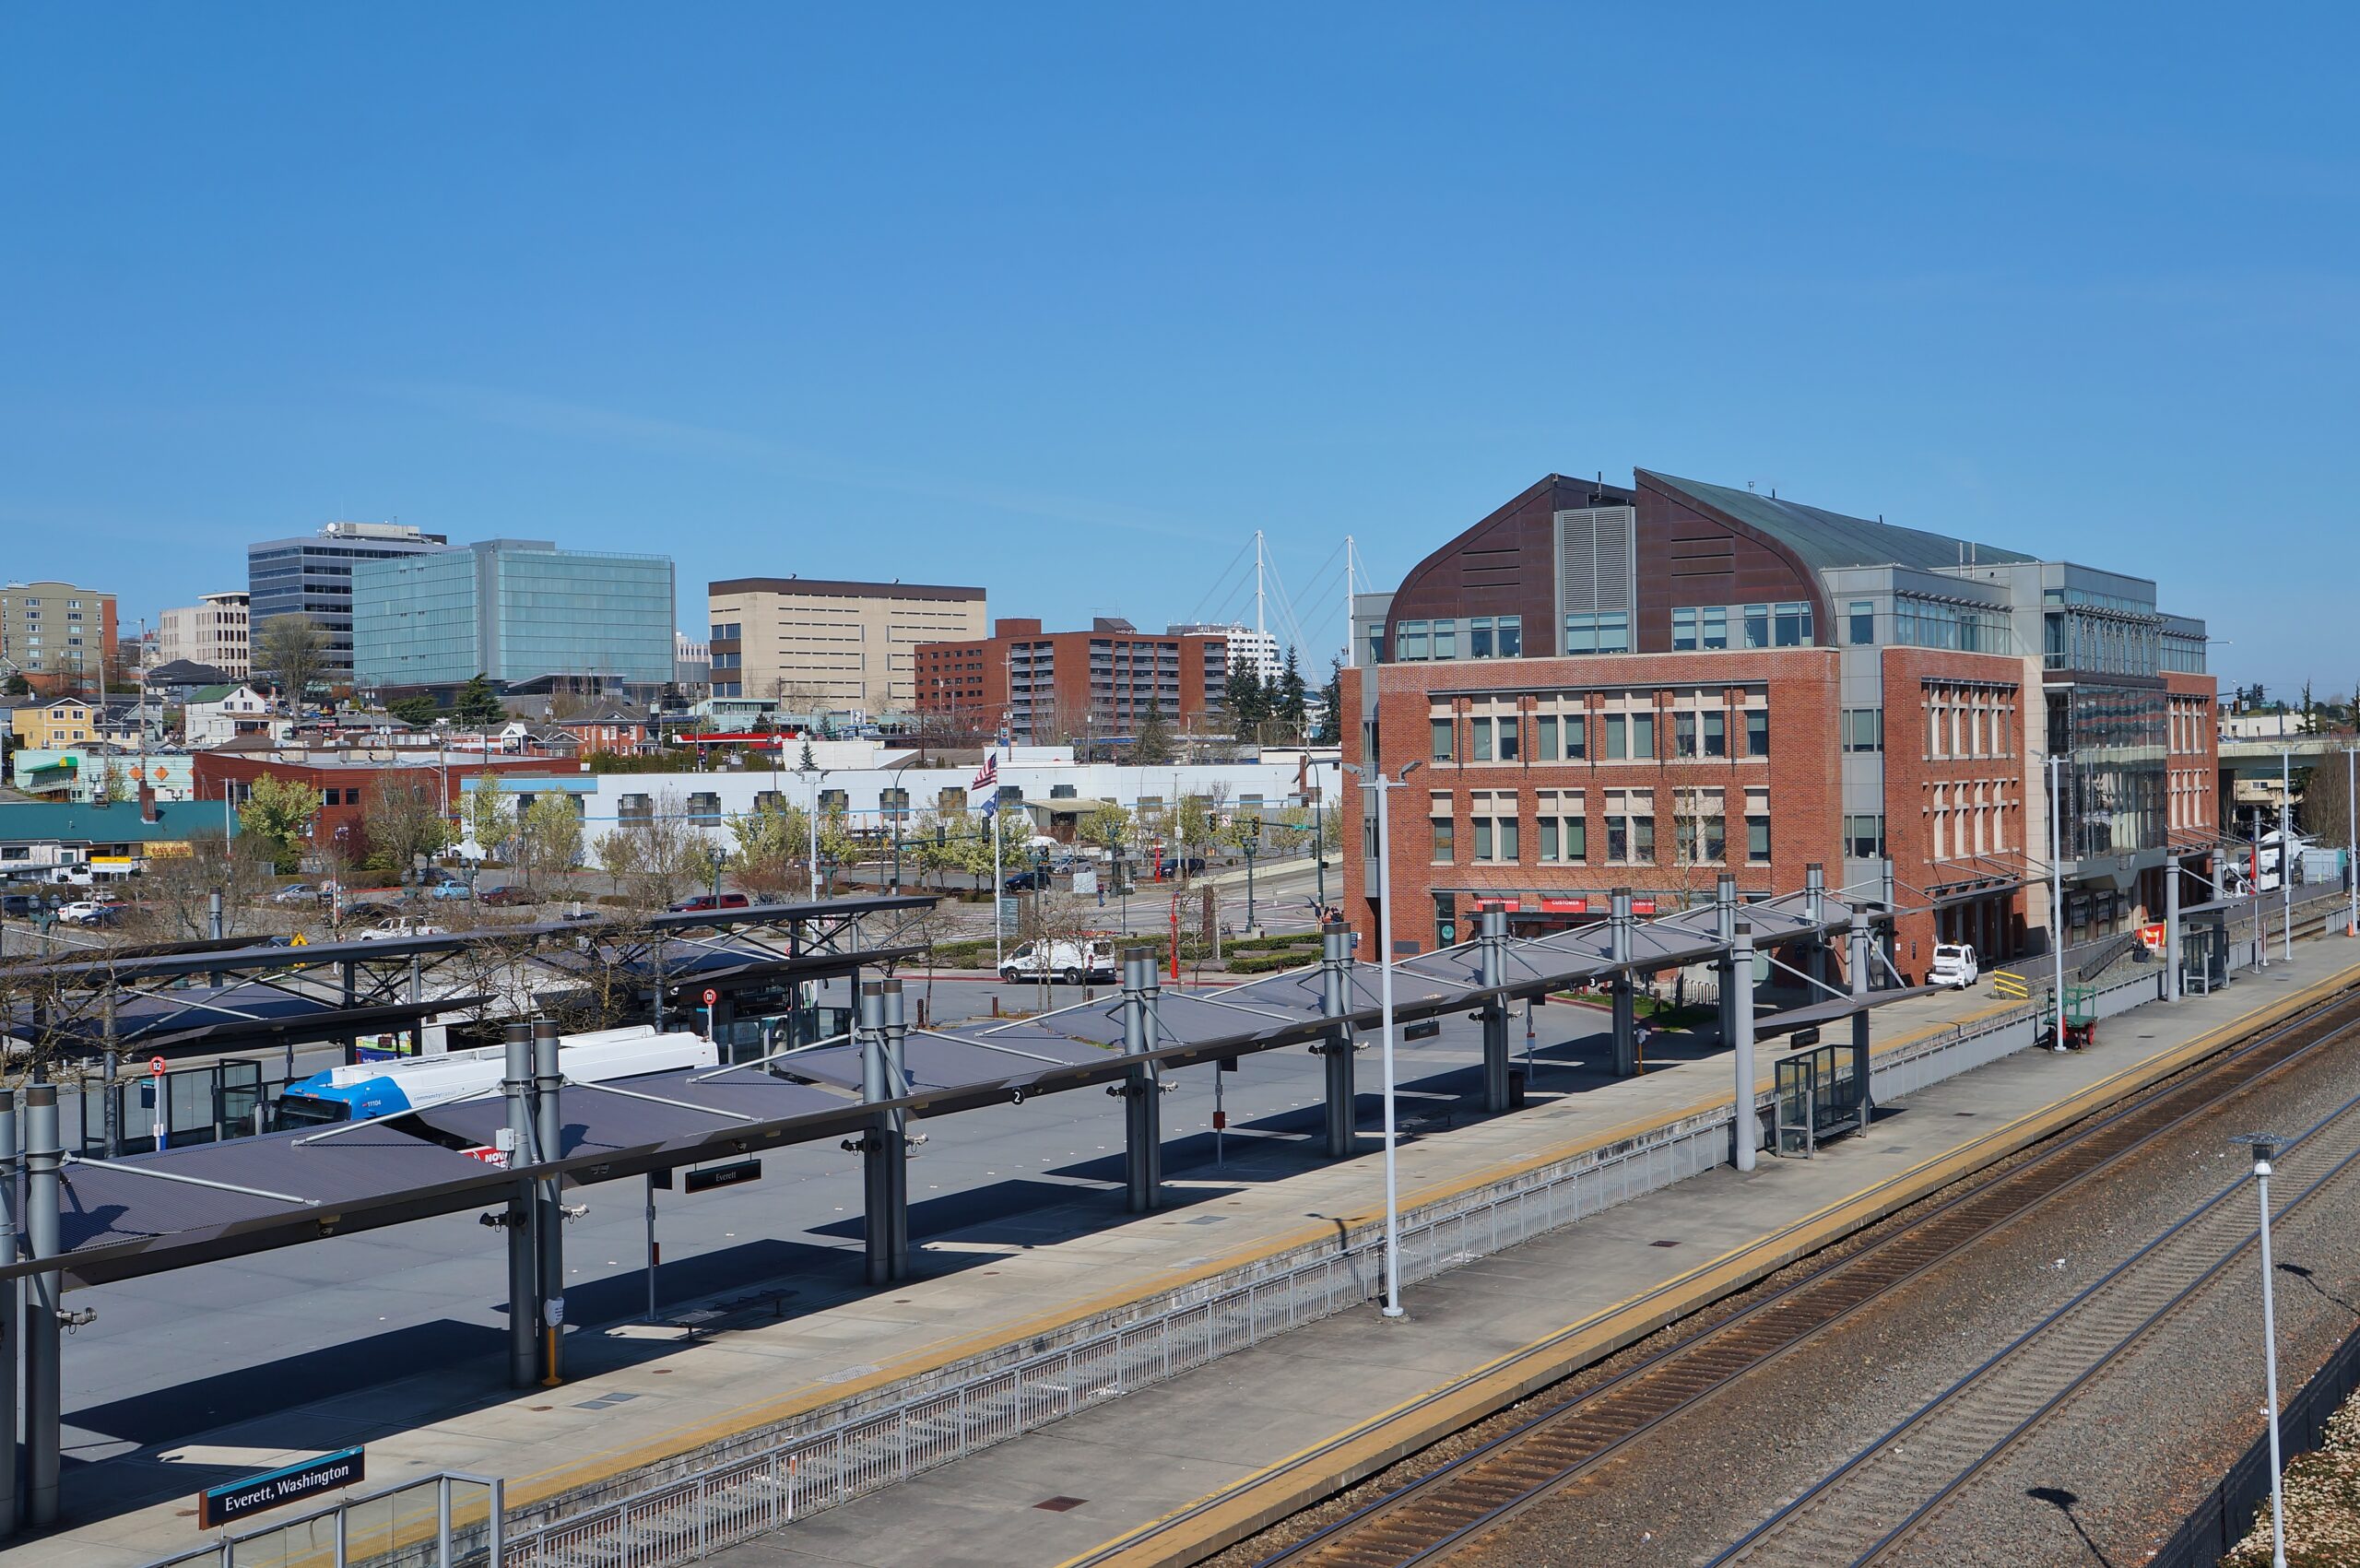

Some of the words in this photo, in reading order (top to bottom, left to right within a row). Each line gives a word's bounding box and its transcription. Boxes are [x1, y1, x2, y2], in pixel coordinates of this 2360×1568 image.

[1589, 977, 1596, 987] 3
[153, 1062, 162, 1070] B2
[1014, 1091, 1021, 1102] 2
[367, 1099, 382, 1107] 11104
[715, 1171, 737, 1182] Everett
[225, 1485, 275, 1512] Everett,
[277, 1465, 349, 1495] Washington
